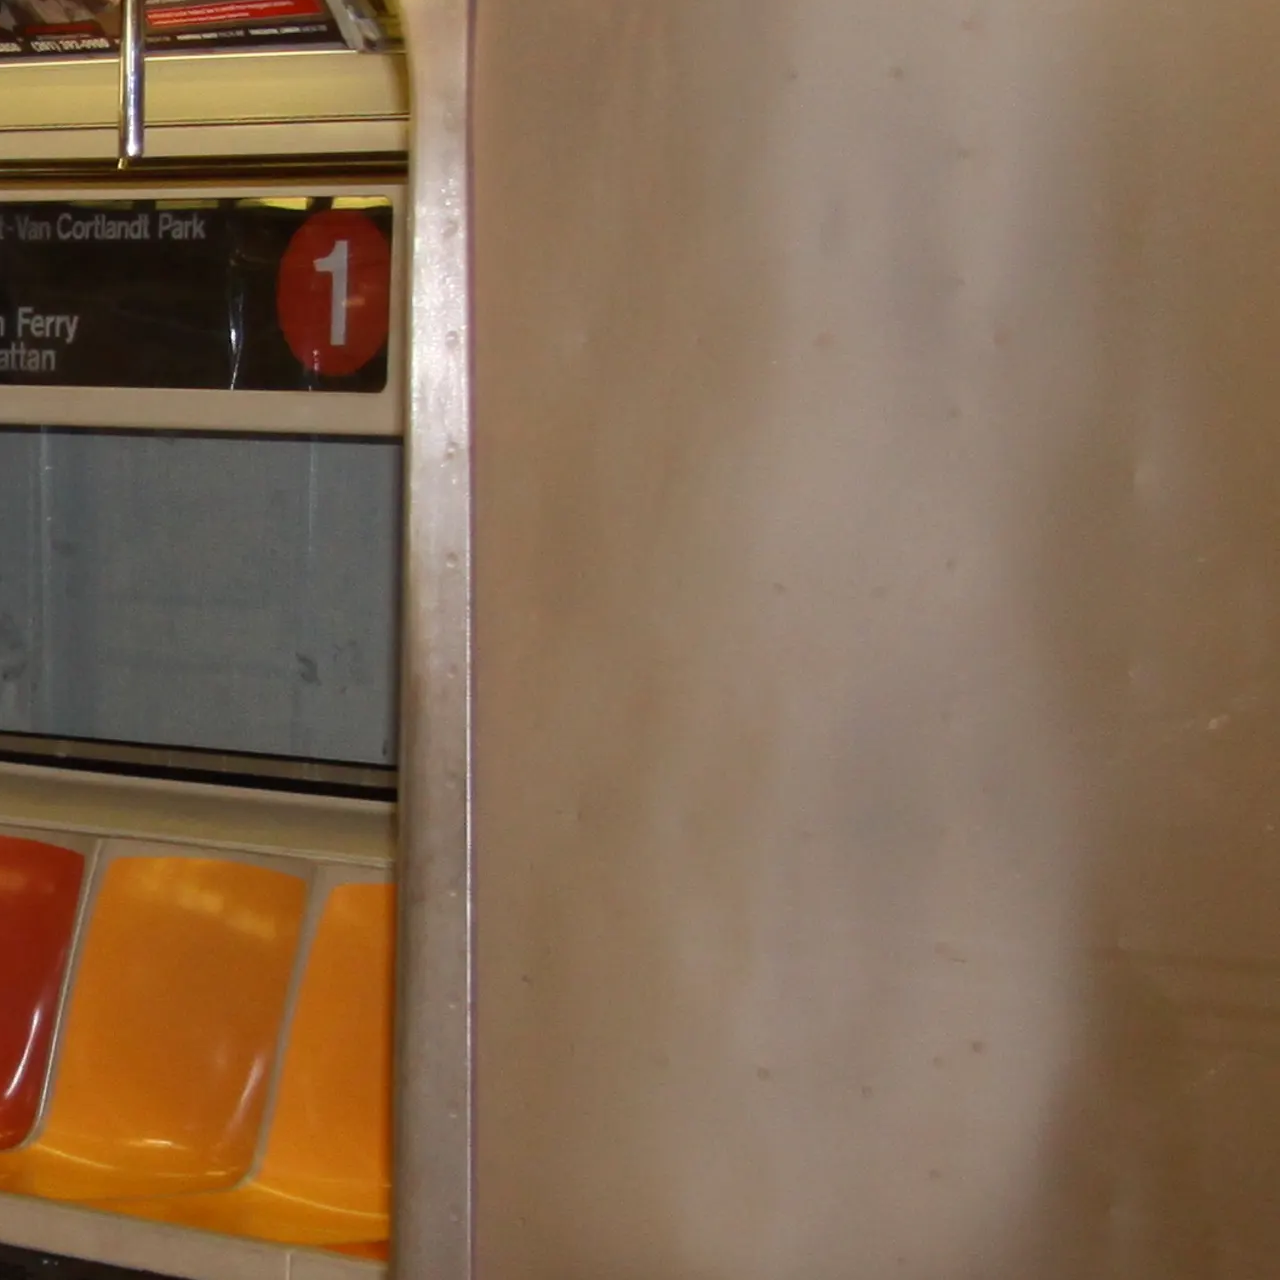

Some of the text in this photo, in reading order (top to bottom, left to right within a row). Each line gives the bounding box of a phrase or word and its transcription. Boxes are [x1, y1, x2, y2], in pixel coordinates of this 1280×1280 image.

[56, 212, 151, 240] Cortlandt
[157, 213, 207, 240] Park
[313, 240, 349, 346] 1
[16, 306, 79, 344] Ferry
